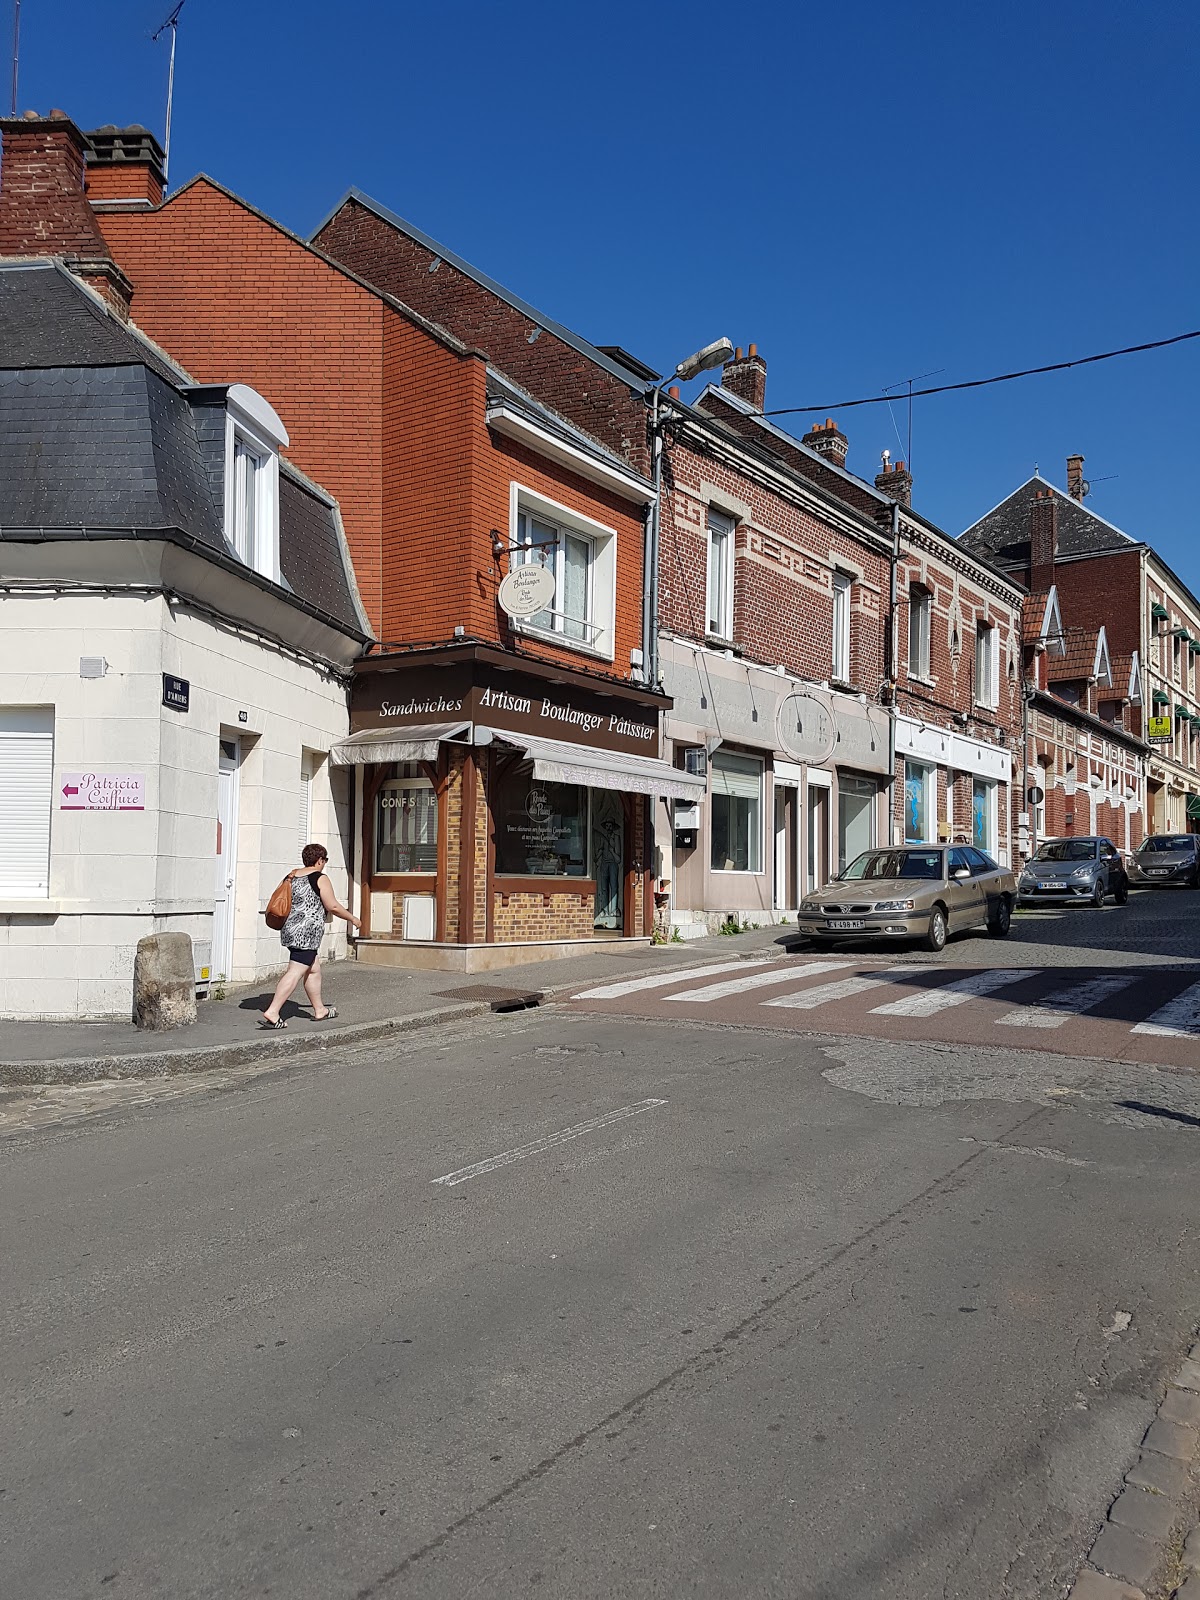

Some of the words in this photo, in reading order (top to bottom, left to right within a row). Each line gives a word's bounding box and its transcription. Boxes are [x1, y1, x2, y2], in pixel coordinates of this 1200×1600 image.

[518, 571, 537, 580] Artisan
[513, 578, 540, 589] Boulanger
[173, 681, 182, 692] RUE
[379, 696, 463, 717] Sandwiches
[479, 686, 531, 713] Artisan
[540, 697, 604, 732] Boulanger
[607, 713, 656, 741] Pâtissier
[79, 773, 141, 790] Patricia
[87, 789, 140, 809] Coiffure
[531, 791, 547, 804] Ronde
